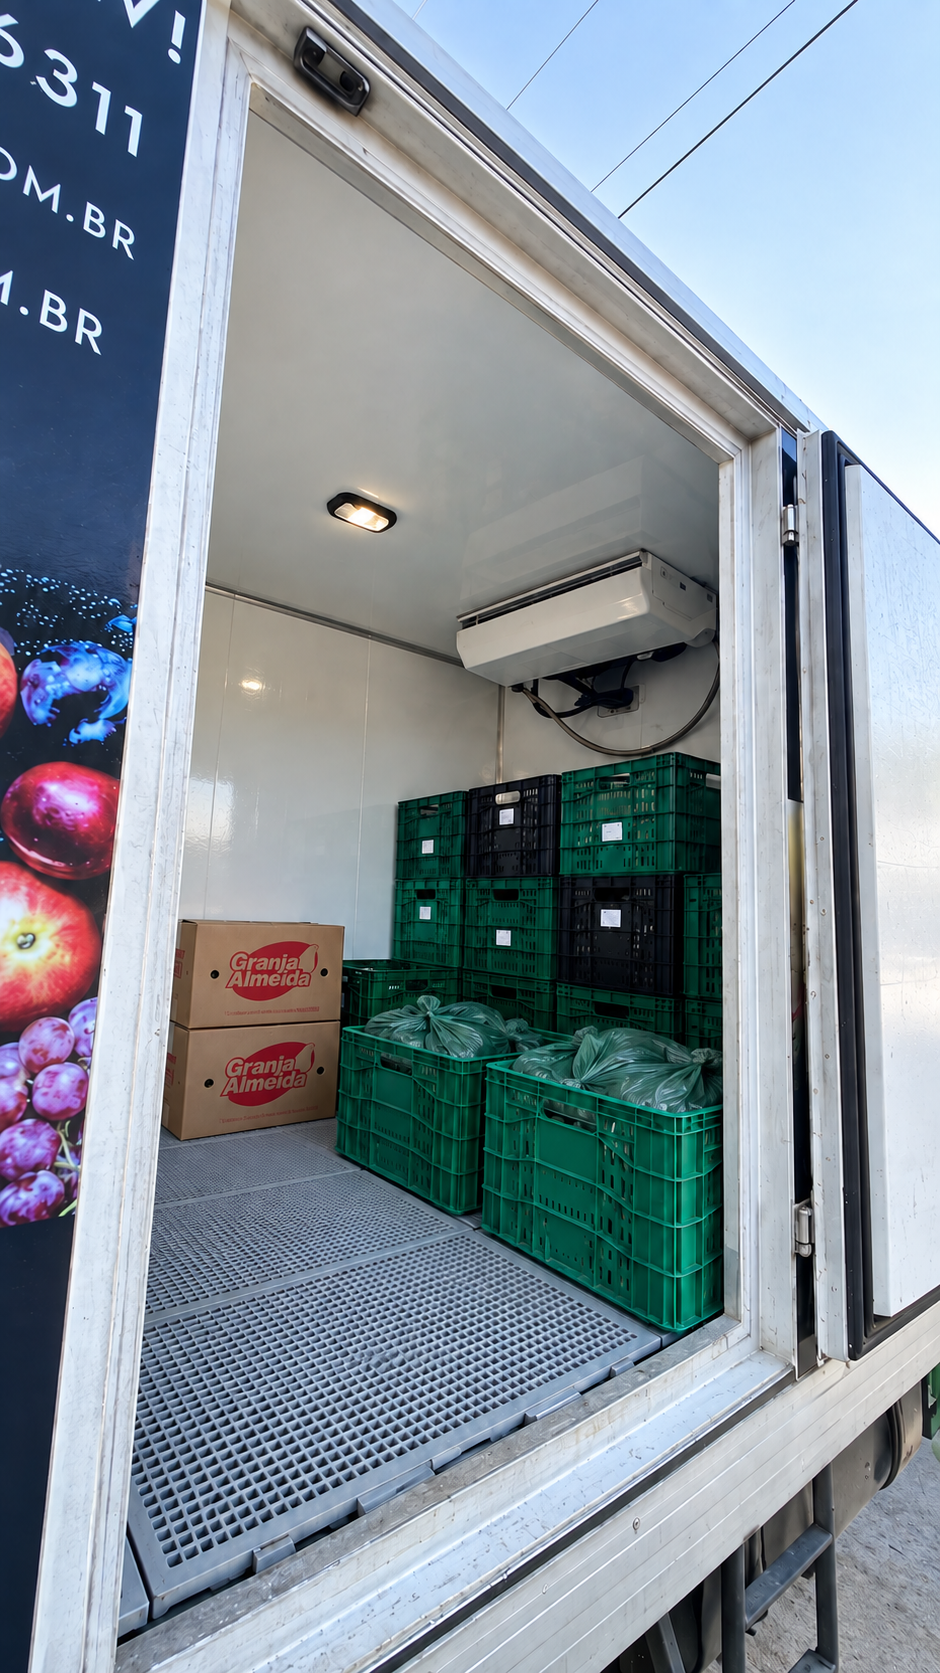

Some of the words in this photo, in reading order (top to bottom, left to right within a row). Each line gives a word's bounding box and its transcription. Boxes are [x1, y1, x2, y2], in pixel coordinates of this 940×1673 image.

[98, 0, 187, 65] V!
[231, 953, 299, 975] Granja
[226, 969, 311, 988] Almeida
[226, 1055, 296, 1080] Granja
[221, 1071, 307, 1097] Almeida
